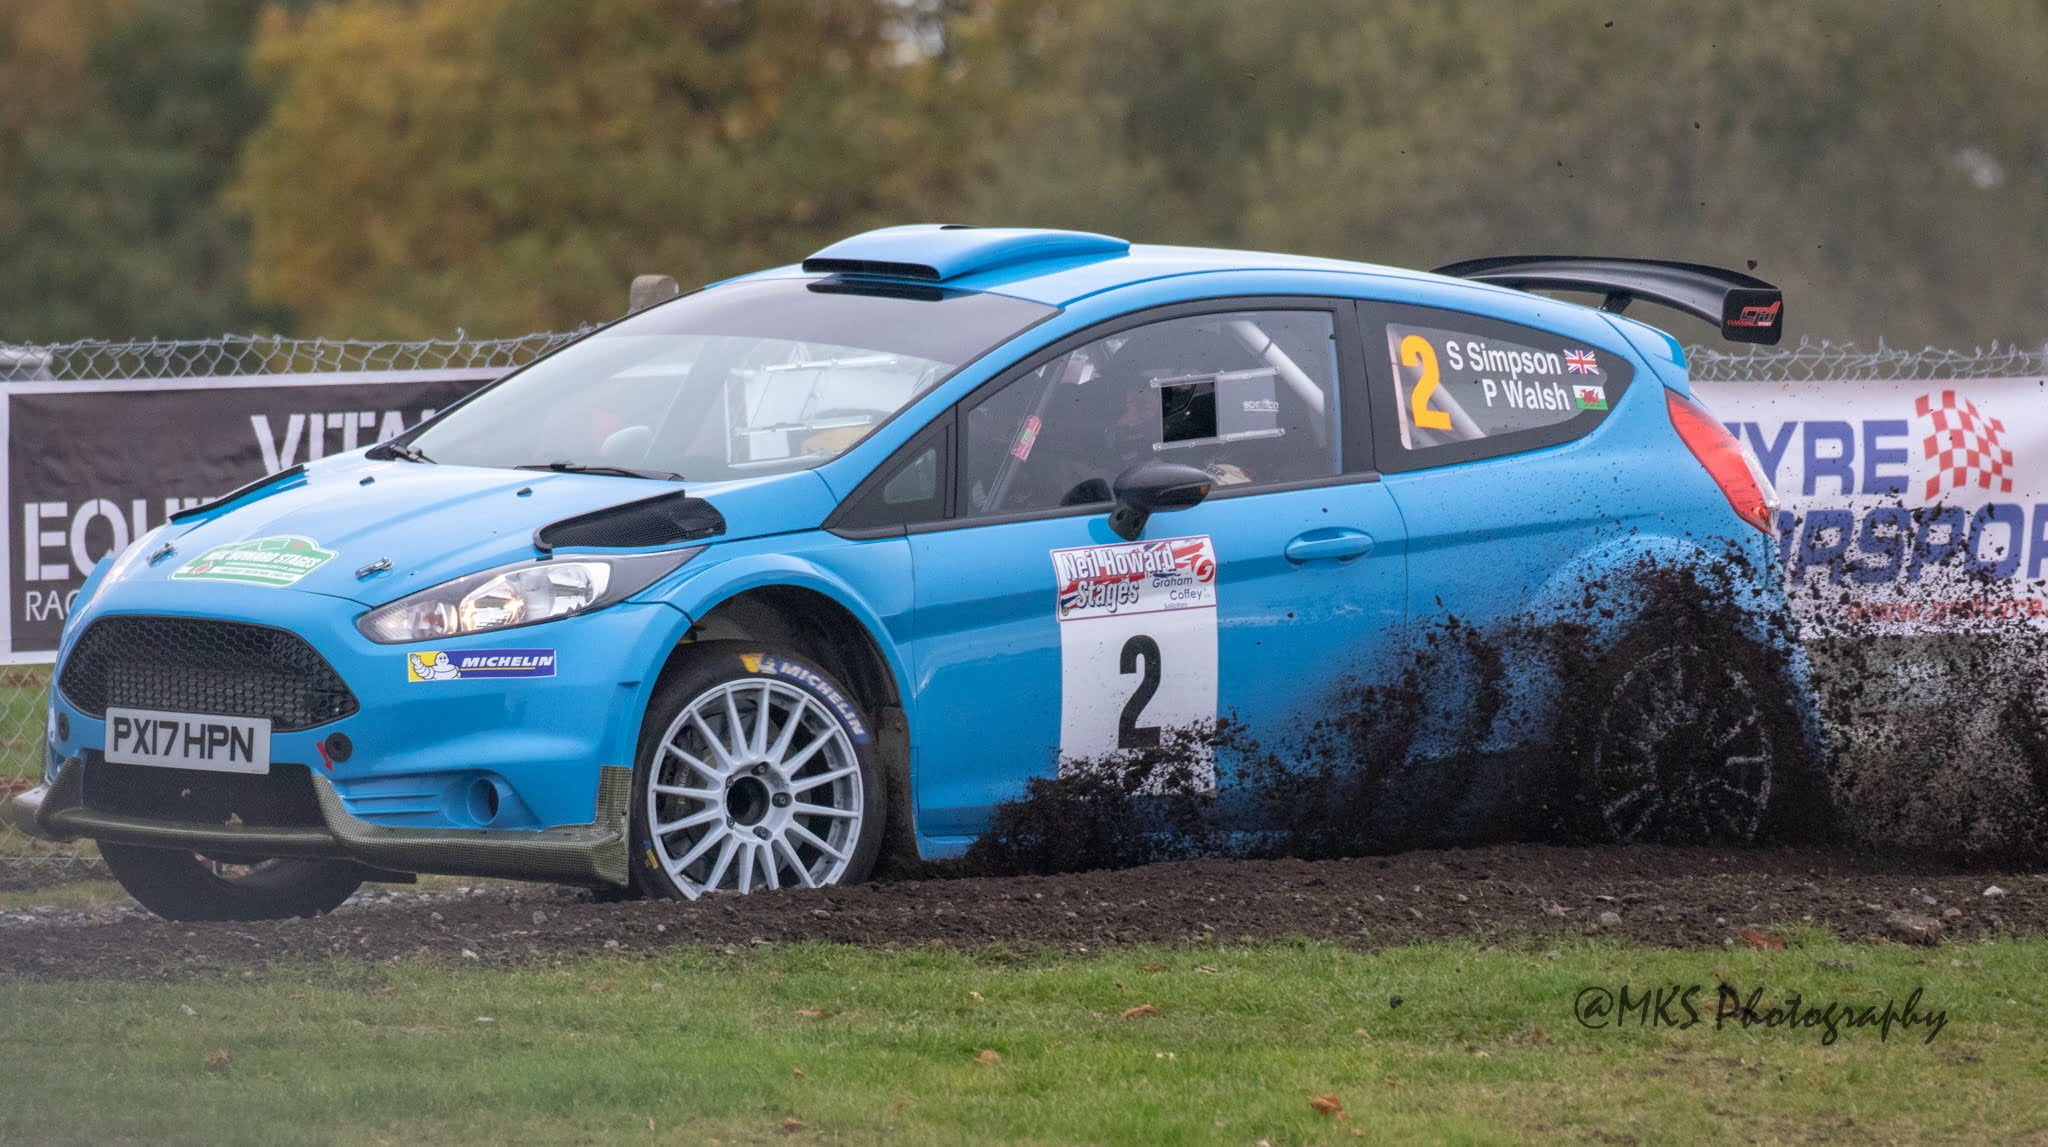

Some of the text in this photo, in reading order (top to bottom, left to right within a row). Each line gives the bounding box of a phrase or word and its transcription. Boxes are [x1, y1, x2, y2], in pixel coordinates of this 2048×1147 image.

[1446, 340, 1562, 380] S Simpson
[1400, 335, 1453, 430] 2
[1481, 379, 1571, 410] P Walsh
[1061, 541, 1177, 581] Neil Howard
[1077, 579, 1140, 613] Stages
[1152, 575, 1193, 589] Graham
[1169, 588, 1203, 602] Coffey
[461, 656, 554, 668] MICHELIN
[780, 662, 866, 735] MICHELIN
[1119, 634, 1162, 750] 2
[113, 716, 255, 763] PX17 HPN
